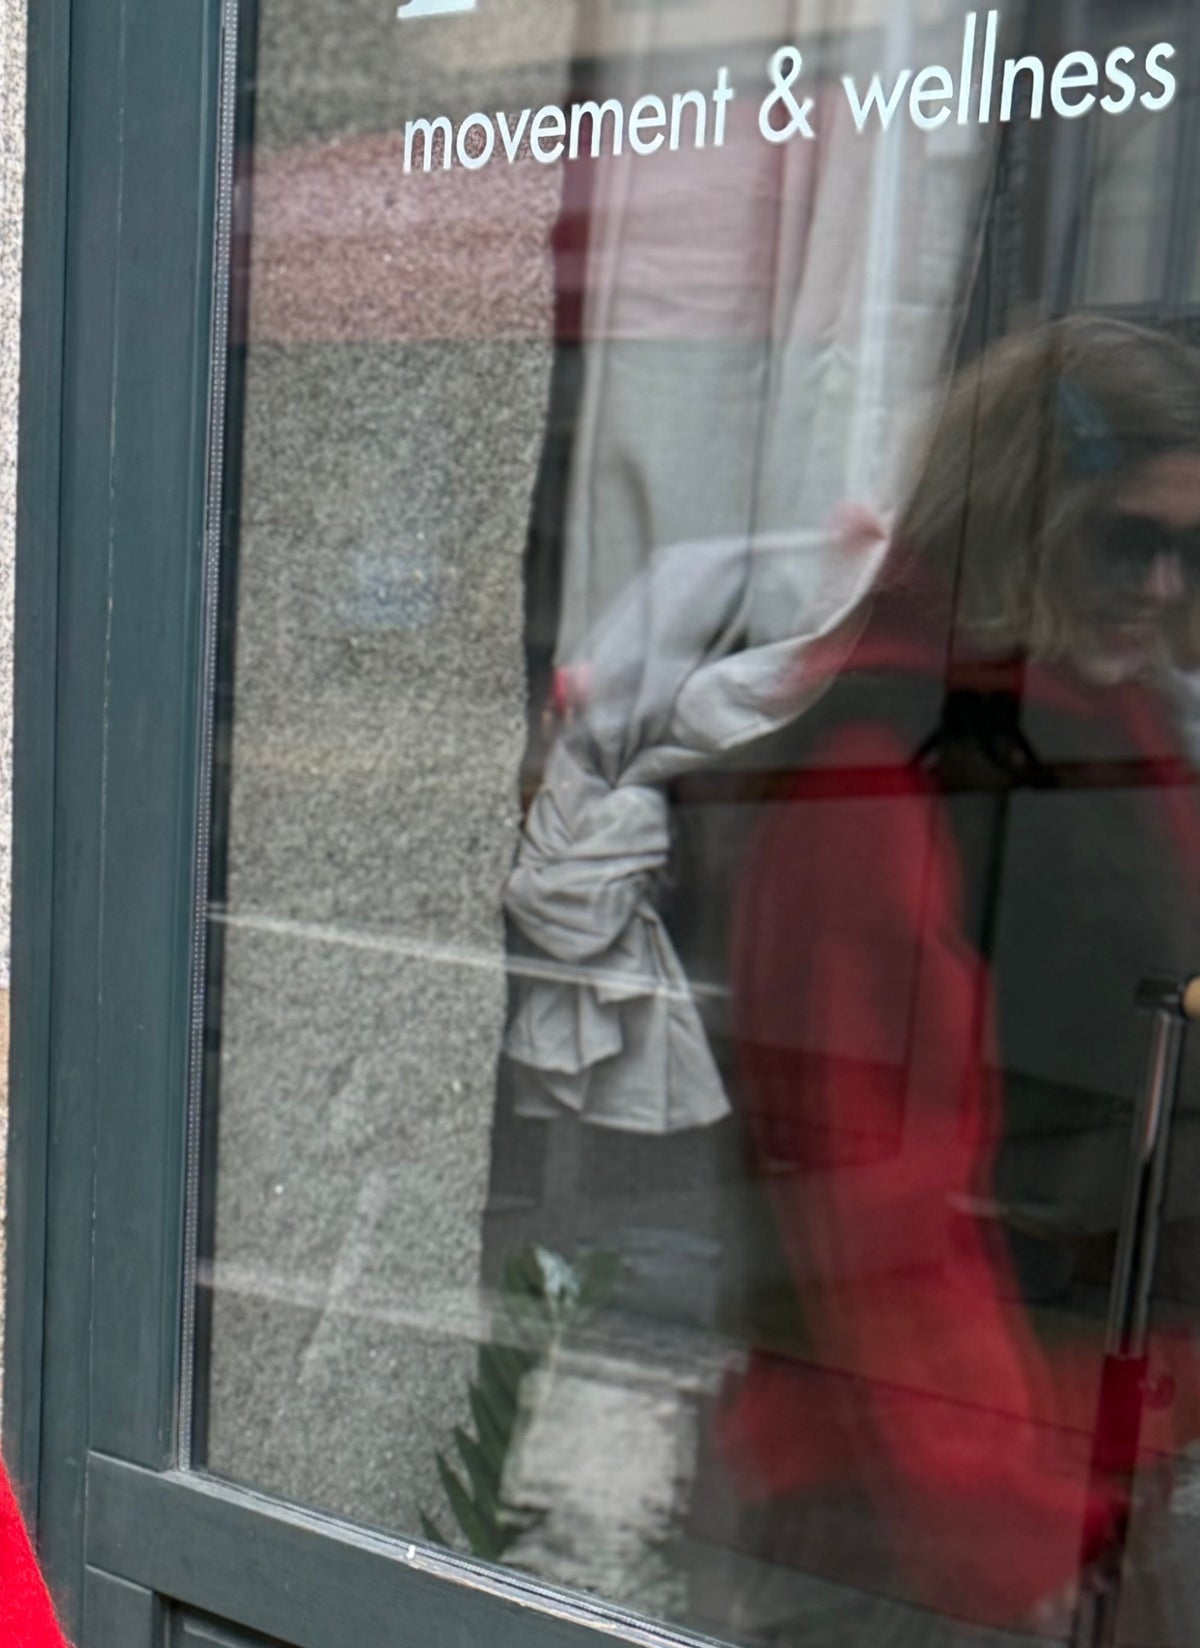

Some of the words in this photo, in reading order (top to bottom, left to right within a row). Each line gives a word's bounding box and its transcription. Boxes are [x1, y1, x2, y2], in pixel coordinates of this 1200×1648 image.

[403, 67, 734, 174] movement
[759, 46, 815, 143] &
[842, 10, 1176, 132] wellness
